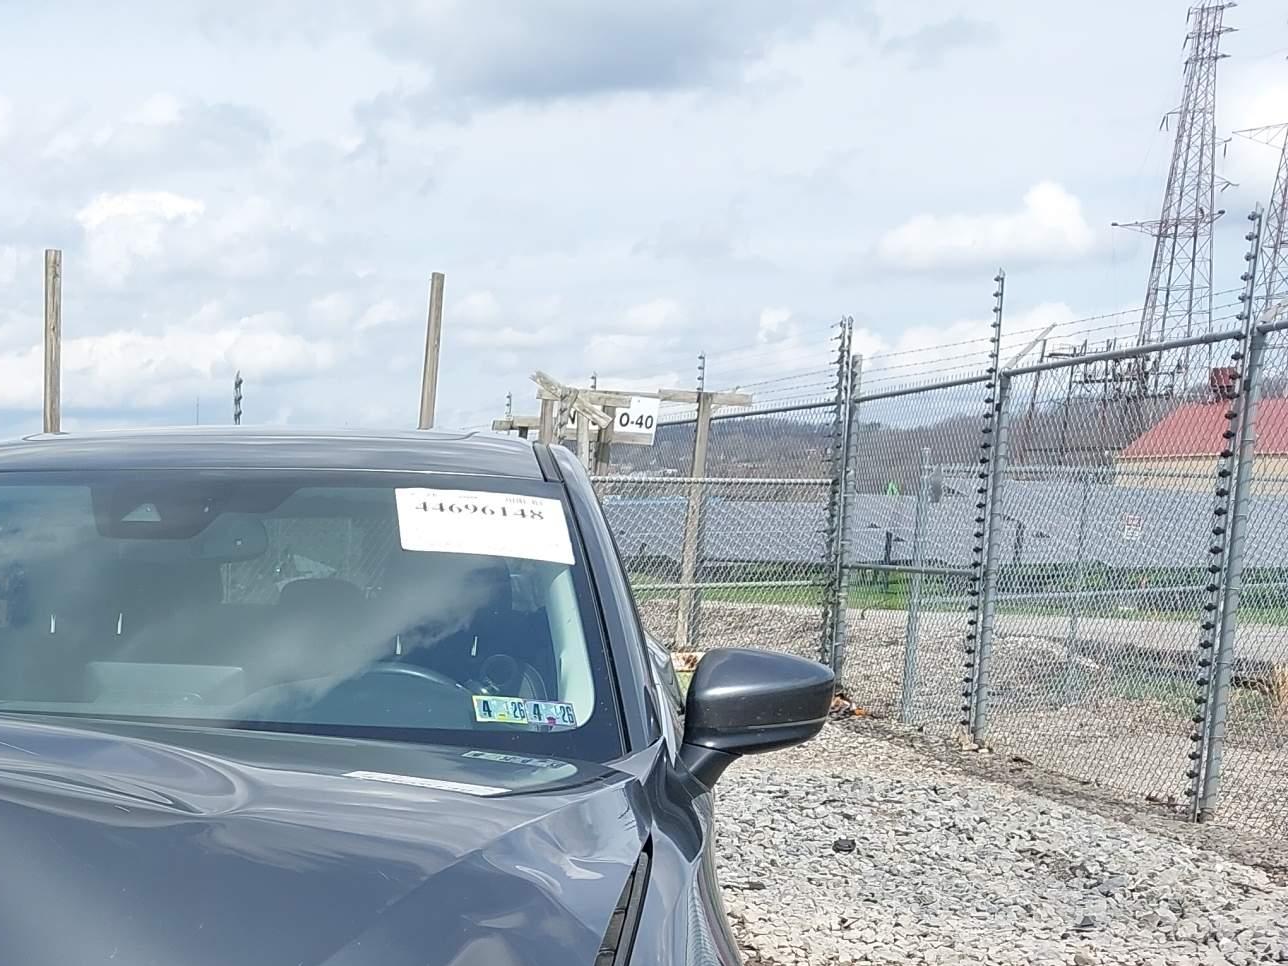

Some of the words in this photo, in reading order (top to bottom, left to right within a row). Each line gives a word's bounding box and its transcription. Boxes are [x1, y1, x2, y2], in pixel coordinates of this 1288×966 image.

[619, 410, 654, 430] O-40
[415, 500, 545, 520] 44696148
[482, 700, 493, 718] 4
[533, 703, 542, 721] 4
